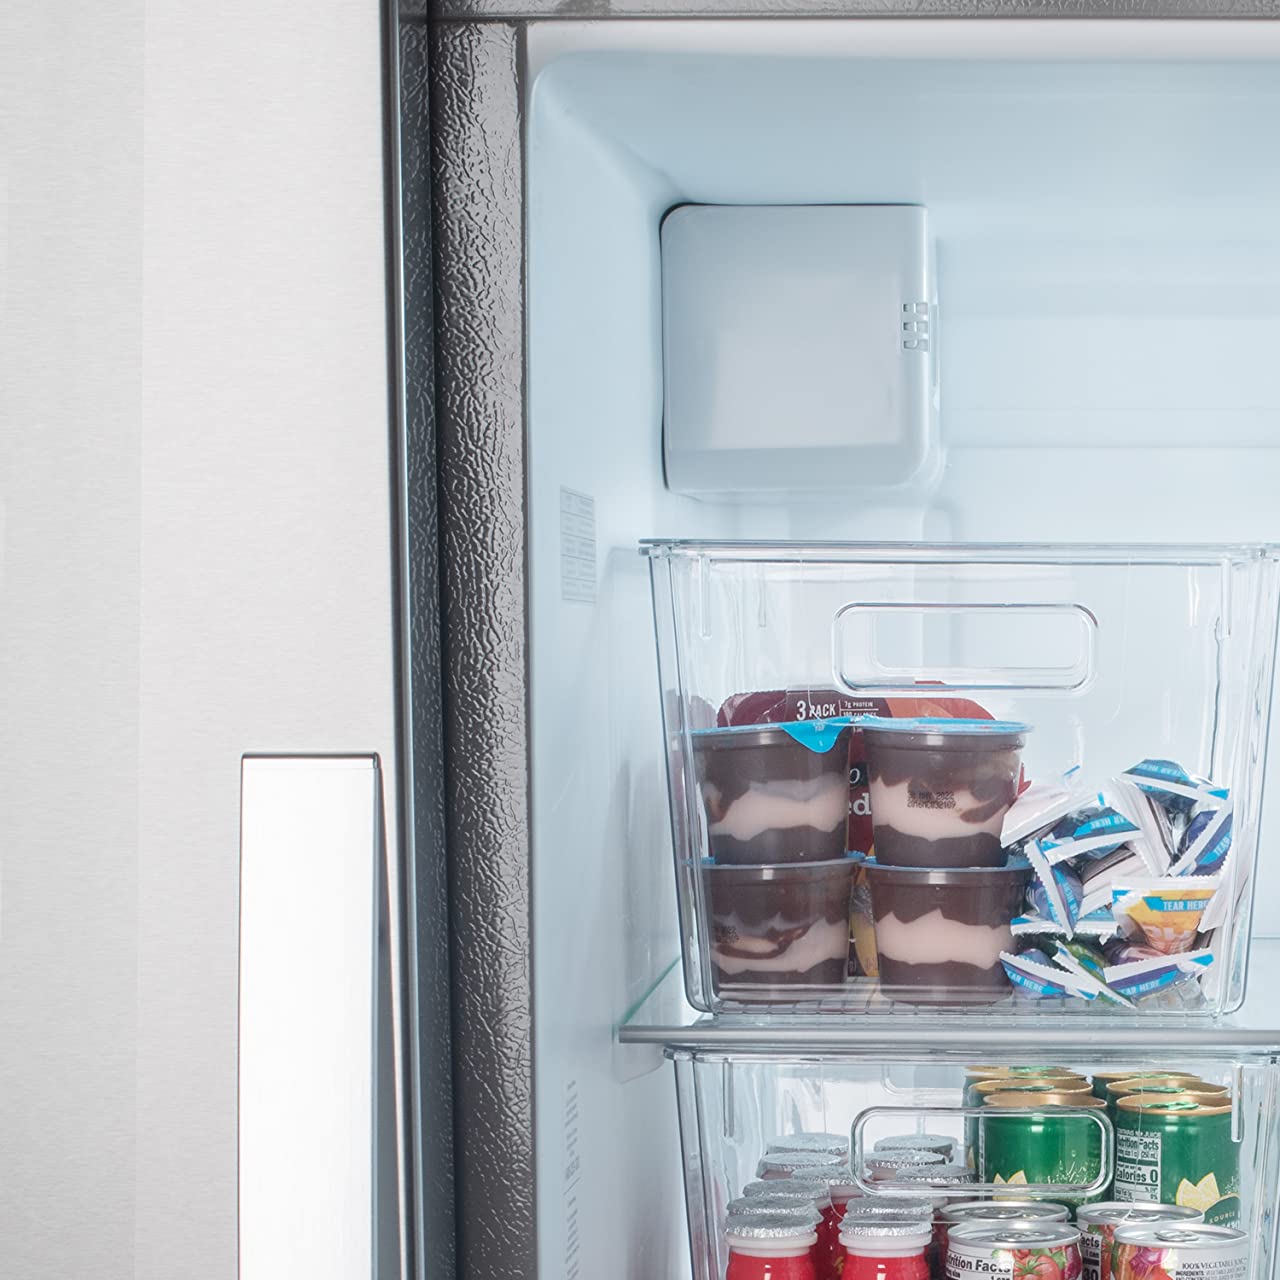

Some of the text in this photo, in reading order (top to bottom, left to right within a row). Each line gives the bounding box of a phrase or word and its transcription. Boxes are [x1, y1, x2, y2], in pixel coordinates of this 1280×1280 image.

[796, 700, 836, 720] 3 PACK
[1163, 901, 1185, 911] TEAR
[1024, 977, 1043, 993] HERE
[1139, 980, 1160, 993] HERE
[1117, 1168, 1158, 1183] Calories 0
